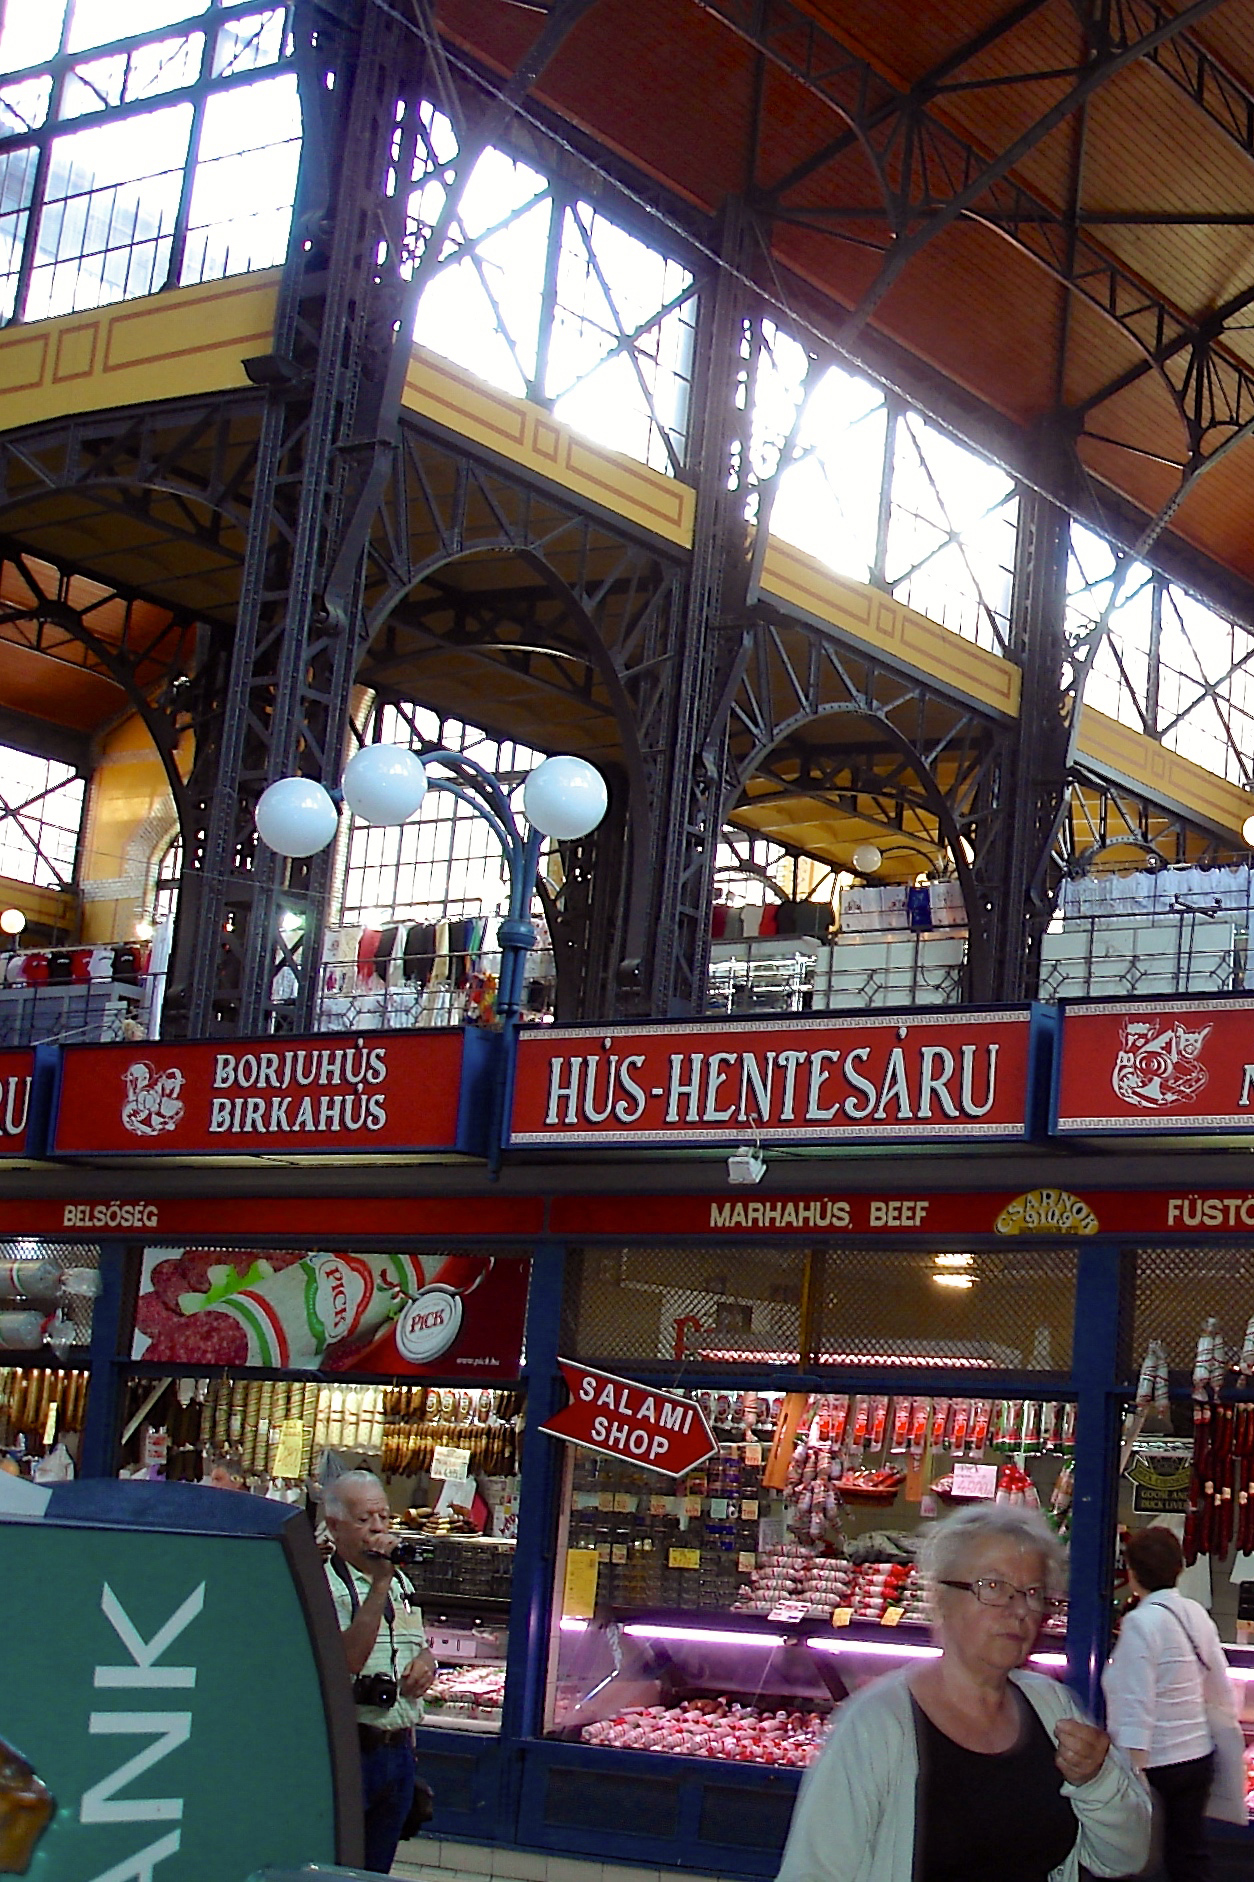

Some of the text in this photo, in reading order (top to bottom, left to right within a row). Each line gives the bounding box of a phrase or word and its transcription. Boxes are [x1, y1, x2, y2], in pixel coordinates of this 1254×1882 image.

[212, 1037, 388, 1090] BORJUHÚS
[545, 1027, 1000, 1125] HÚS-HENTESÁRU
[208, 1083, 388, 1134] BIRKAHÚS
[63, 1201, 159, 1228] BELSŐSÉG
[710, 1198, 930, 1230] MARHAHÚS, BEEF
[994, 1189, 1099, 1235] CSARNOK
[324, 1266, 348, 1330] PICK
[408, 1308, 446, 1335] PICK
[579, 1377, 693, 1434] SALAMI
[591, 1416, 669, 1460] SHOP
